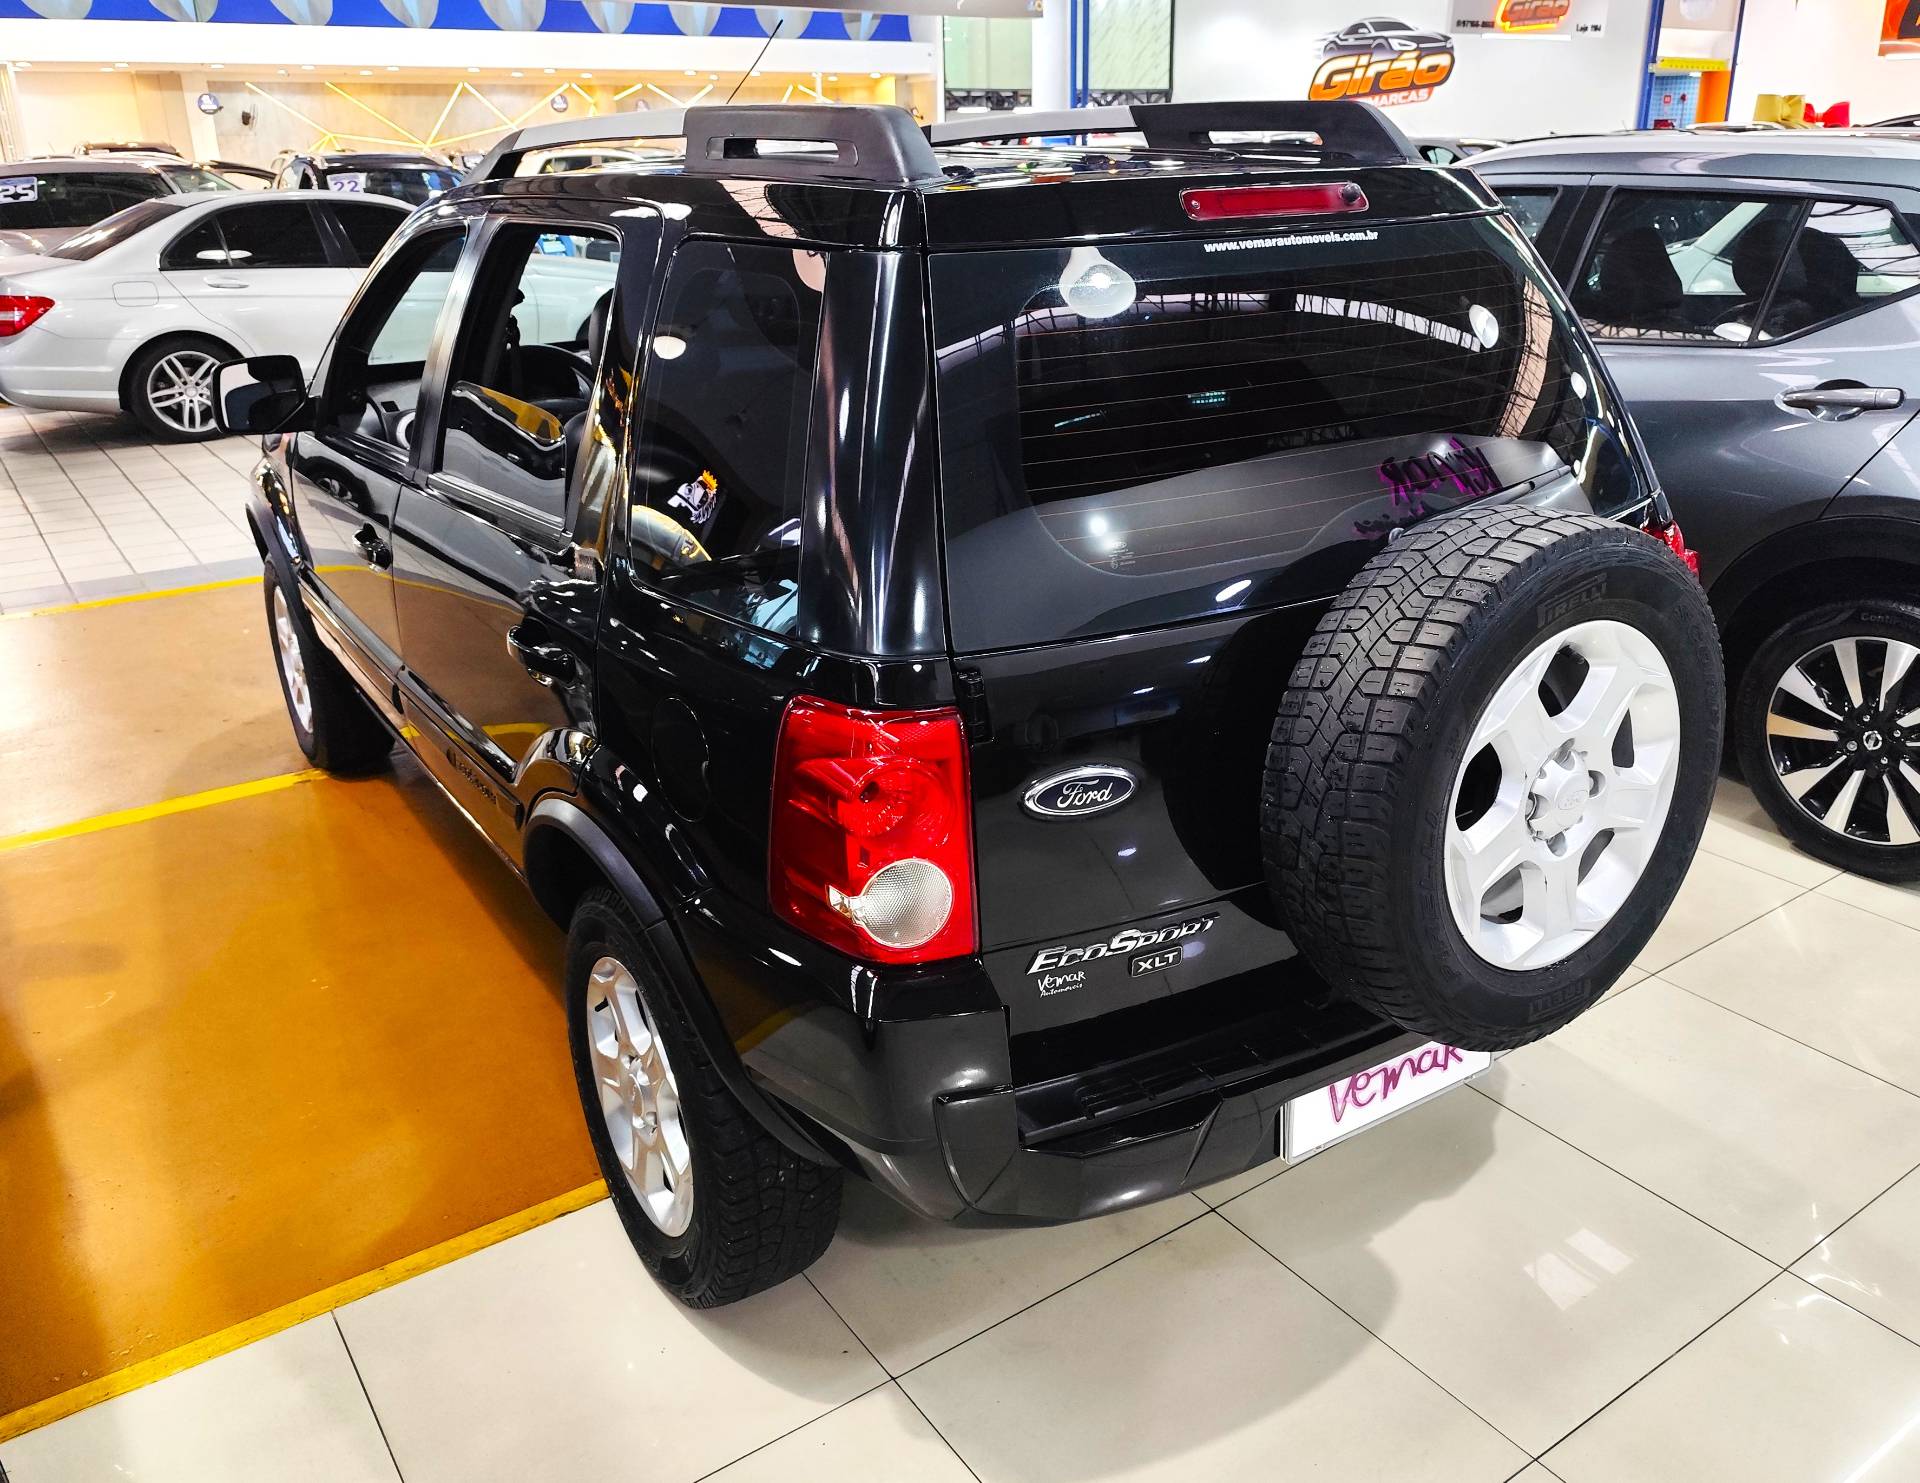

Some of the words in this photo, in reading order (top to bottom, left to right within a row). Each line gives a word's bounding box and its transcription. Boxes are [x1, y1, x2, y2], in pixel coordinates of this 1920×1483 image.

[1203, 229, 1379, 253] www.vemarautomoveis.com.br
[1056, 778, 1114, 808] Ford
[1136, 950, 1179, 974] XLT
